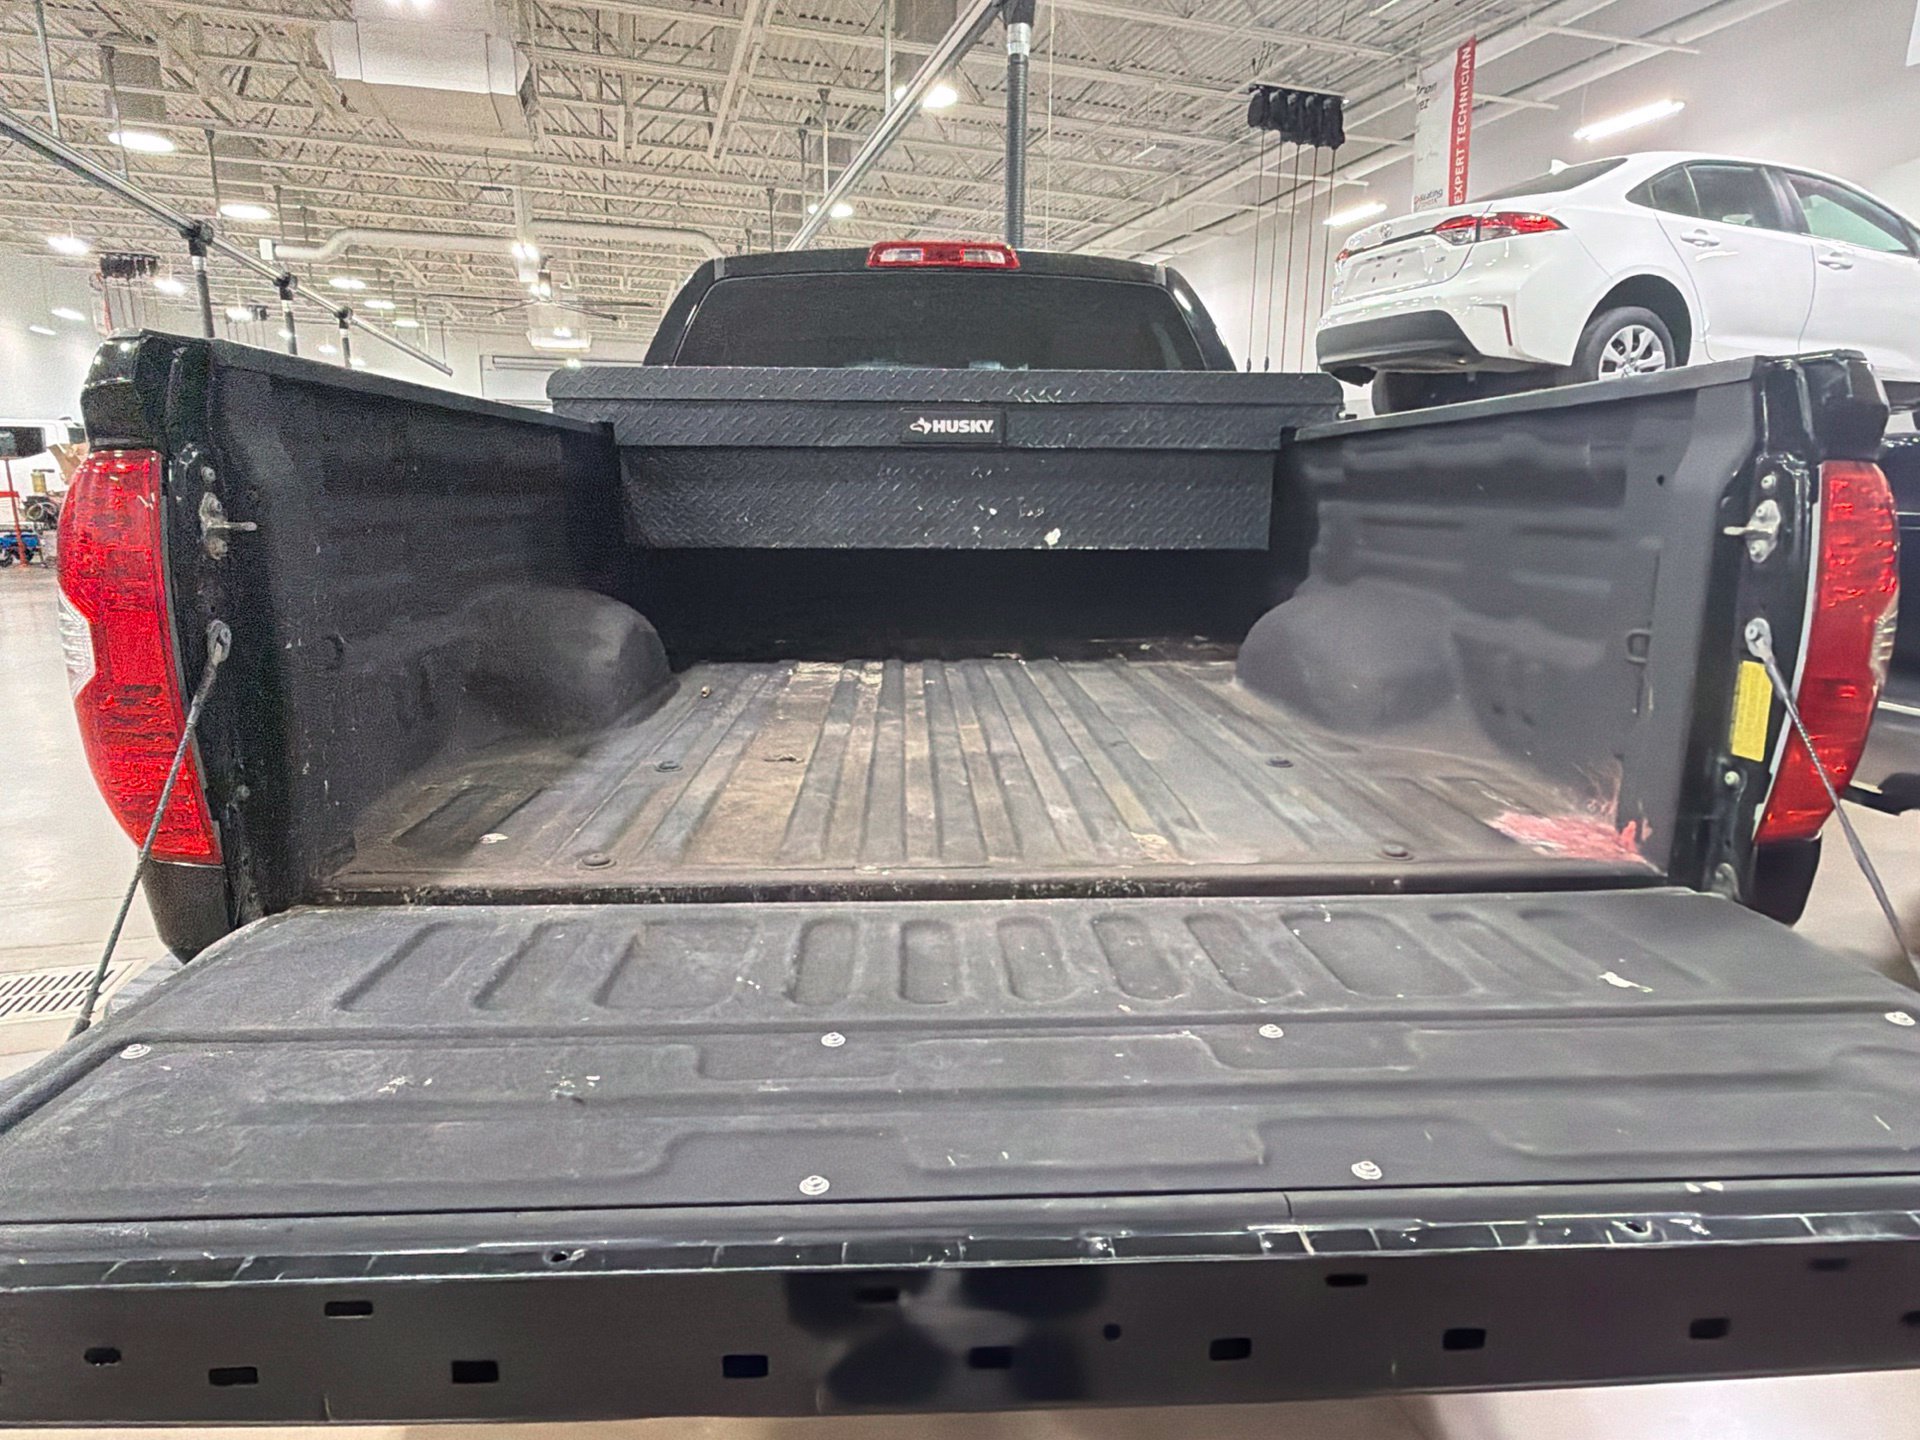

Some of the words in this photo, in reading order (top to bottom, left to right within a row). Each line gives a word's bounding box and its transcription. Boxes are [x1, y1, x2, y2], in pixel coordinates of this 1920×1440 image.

[1456, 46, 1472, 144] TECHNICIAN
[1454, 149, 1465, 204] EXPERT
[932, 419, 994, 433] HUSKY
